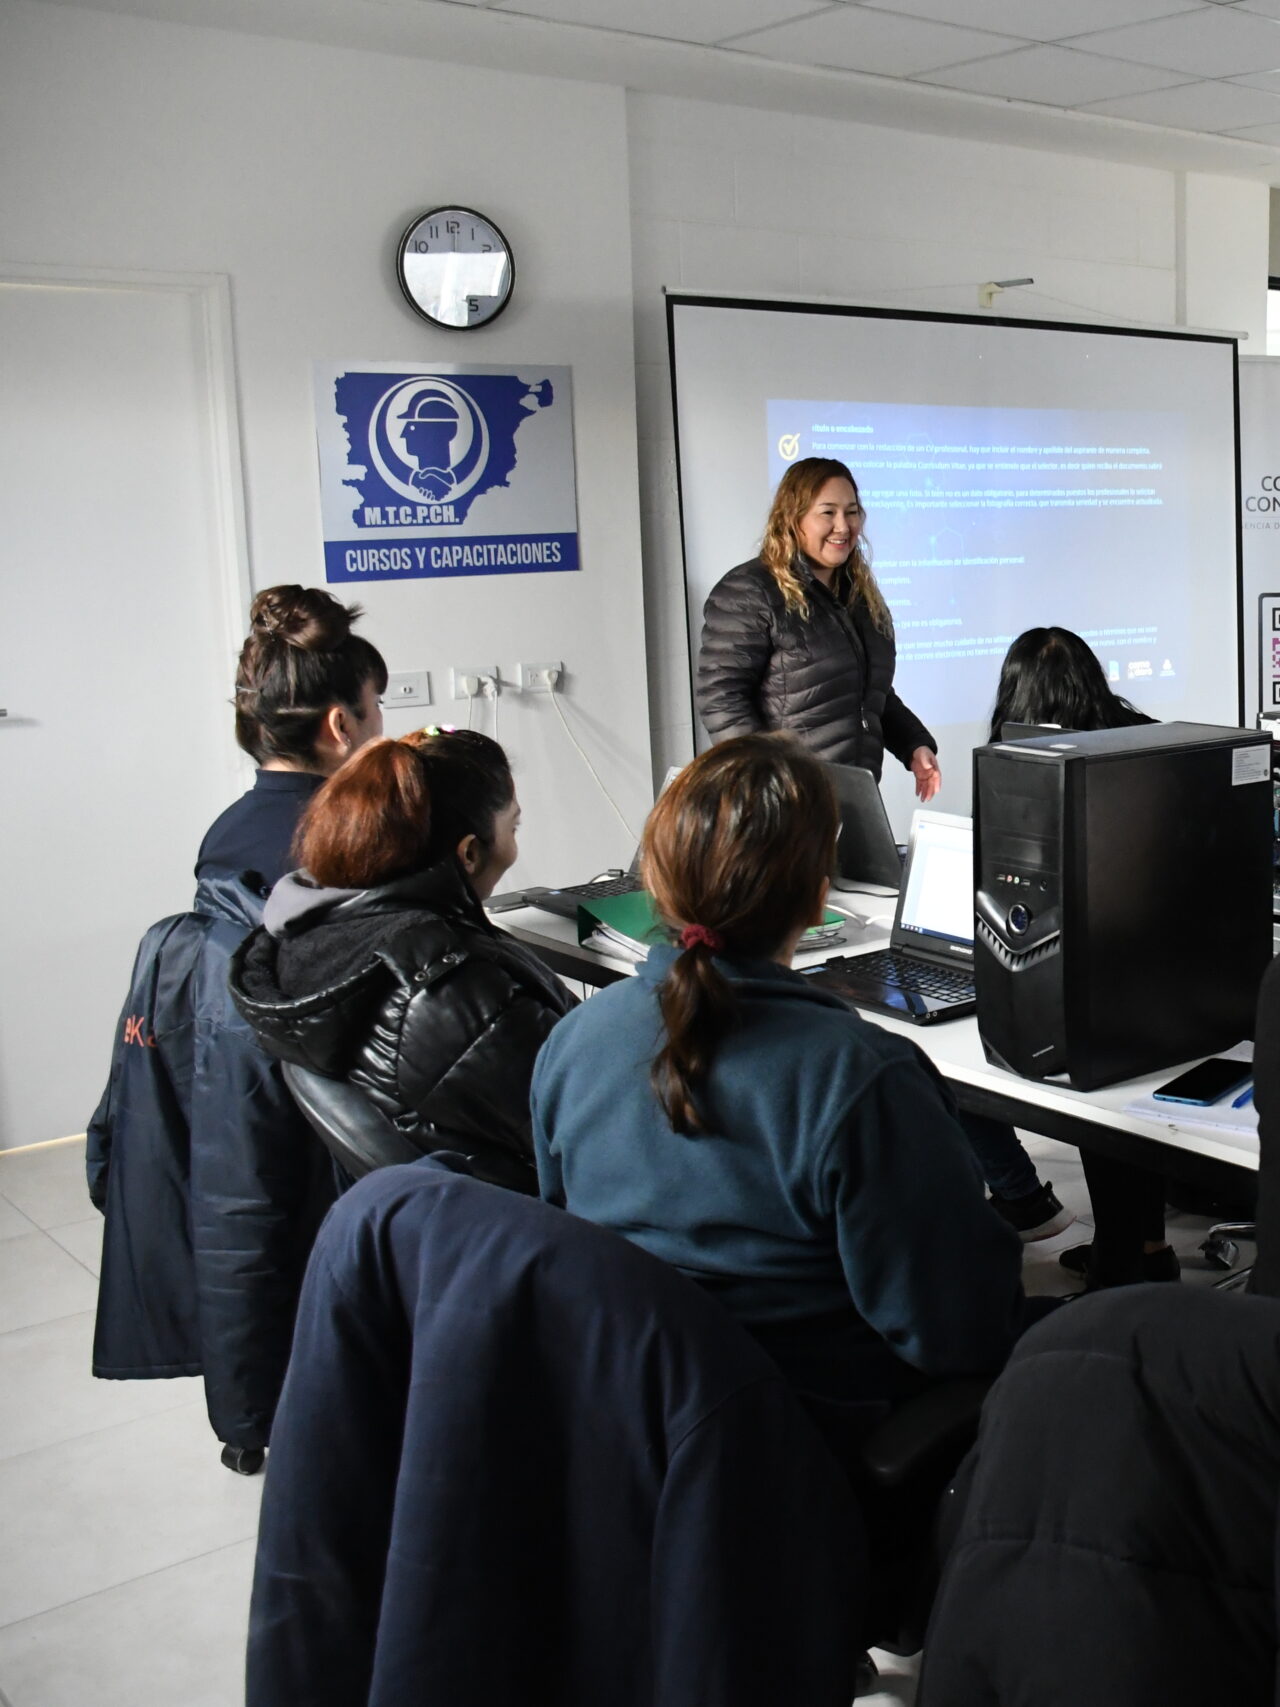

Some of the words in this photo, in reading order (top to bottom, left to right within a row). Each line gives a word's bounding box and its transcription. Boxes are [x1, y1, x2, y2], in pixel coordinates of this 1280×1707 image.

[414, 240, 429, 254] 10
[468, 299, 479, 312] 5
[364, 505, 460, 526] M.T.C.P.CH.
[345, 548, 412, 573] CURSOS
[415, 547, 426, 569] Y
[431, 541, 562, 568] CAPACITACIONES
